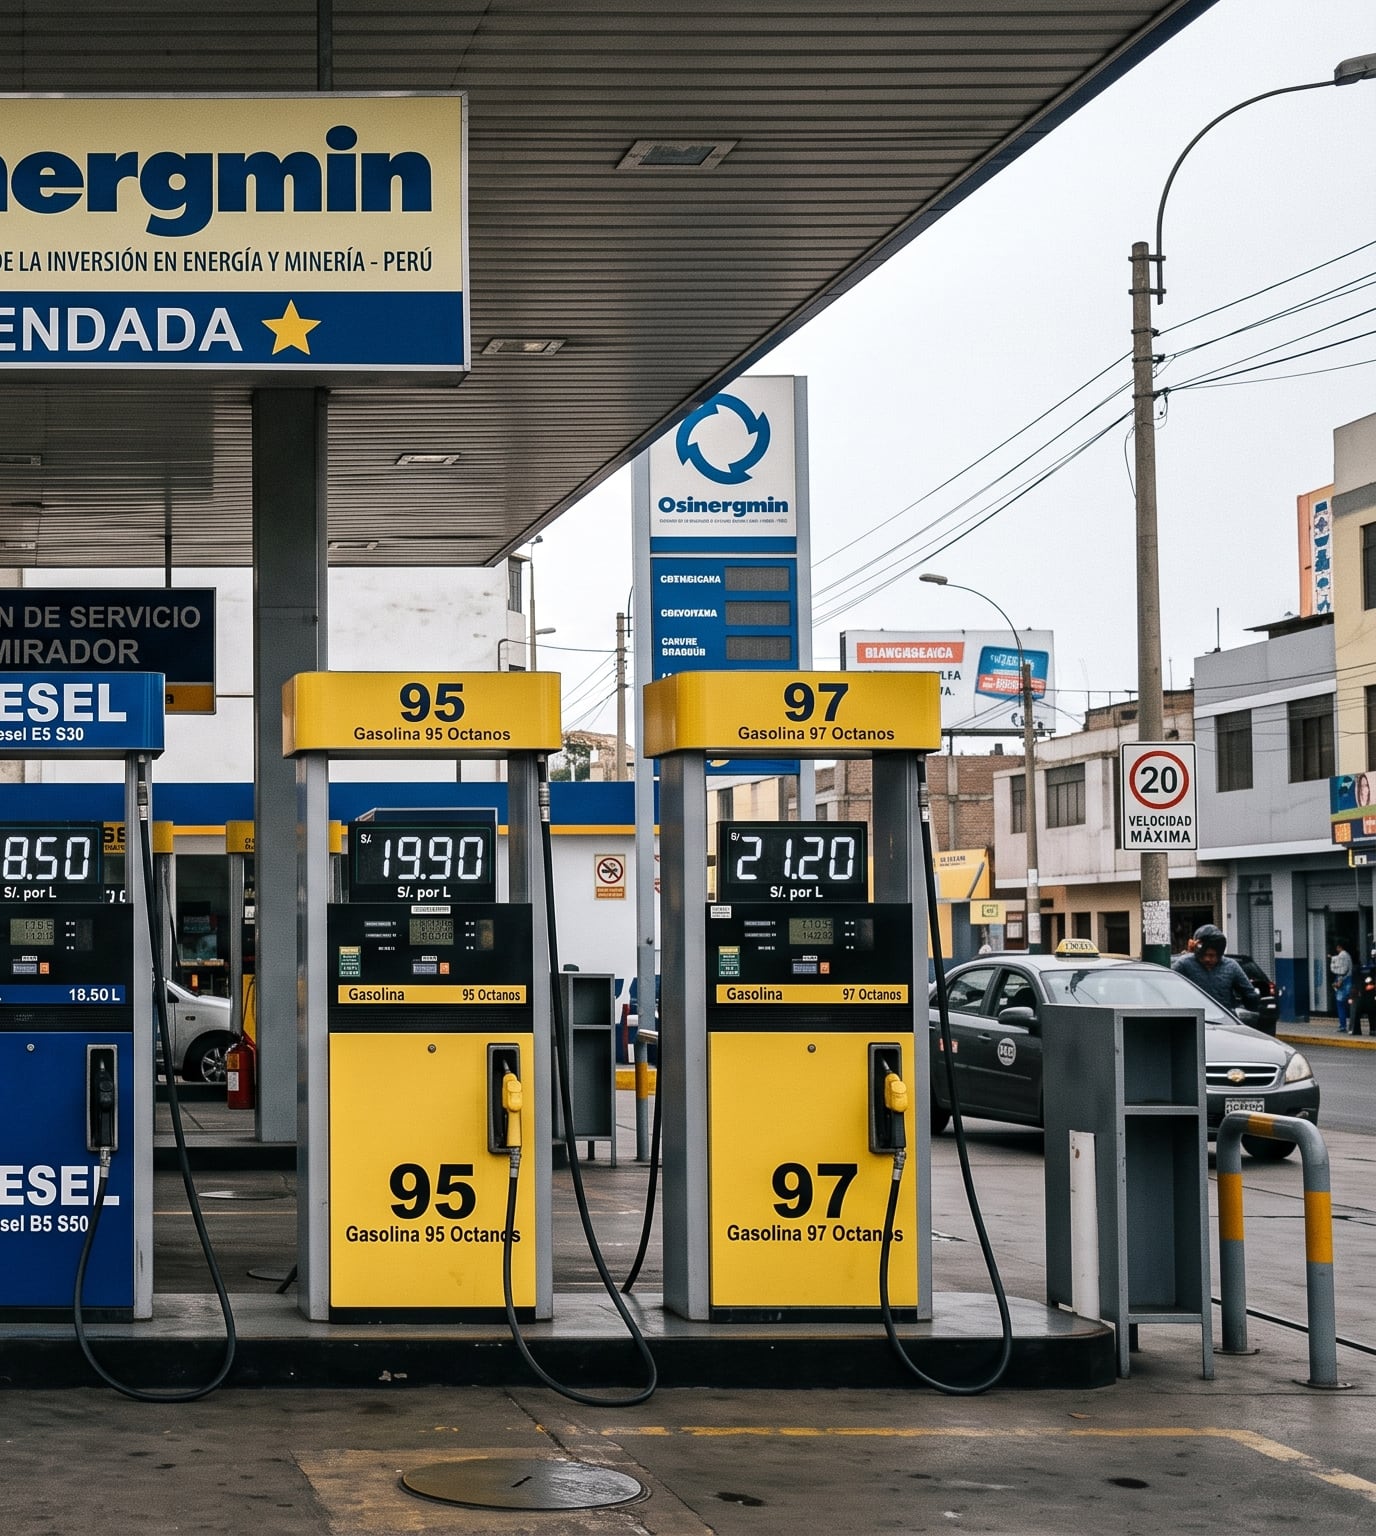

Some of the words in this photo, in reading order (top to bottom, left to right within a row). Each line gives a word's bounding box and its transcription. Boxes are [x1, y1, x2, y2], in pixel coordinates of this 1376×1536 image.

[20, 252, 41, 271] LA
[48, 247, 147, 271] INVERSIÓN
[155, 252, 176, 271] EN
[184, 247, 263, 271] ENERGÍA
[268, 252, 279, 271] Y
[285, 247, 365, 271] MINERÍA
[384, 247, 431, 271] PERÚ
[658, 496, 788, 517] Osinergmin
[25, 607, 60, 627] DE
[70, 606, 200, 628] SERVICIO
[400, 683, 464, 722] 95
[784, 683, 848, 722] 97
[32, 728, 51, 740] E5
[56, 727, 83, 740] S30
[354, 727, 420, 740] Gasolina
[426, 728, 442, 740] 95
[448, 727, 510, 740] Octanos
[739, 727, 804, 739] Gasolina
[810, 727, 826, 740] 97
[832, 727, 894, 740] Octanos
[1141, 767, 1177, 793] 20
[1129, 816, 1192, 827] VELOCIDAD
[1131, 827, 1190, 843] MÁXIMA
[383, 836, 483, 879] 19.90
[736, 836, 855, 879] 21.20
[4, 887, 19, 898] S/.
[24, 890, 45, 901] por
[49, 886, 56, 898] L
[398, 886, 413, 897] S/.
[418, 889, 439, 901] por
[444, 886, 451, 897] L
[770, 886, 785, 897] S/.
[790, 889, 812, 901] por
[816, 886, 823, 897] L
[69, 988, 108, 1001] 18.50
[112, 988, 120, 1001] L
[348, 987, 405, 1001] Gasolina
[462, 989, 475, 1001] 95
[478, 989, 520, 1001] Octanos
[726, 987, 783, 1001] Gasolina
[842, 989, 855, 1001] 97
[858, 989, 902, 1001] Octanos
[389, 1163, 476, 1219] 95
[772, 1162, 858, 1218] 97
[30, 1215, 52, 1232] B5
[57, 1215, 89, 1232] S50
[346, 1225, 420, 1243] Gasolina
[425, 1226, 445, 1243] 95
[727, 1224, 802, 1242] Gasolina
[807, 1225, 827, 1242] 97
[832, 1225, 903, 1242] Octans
